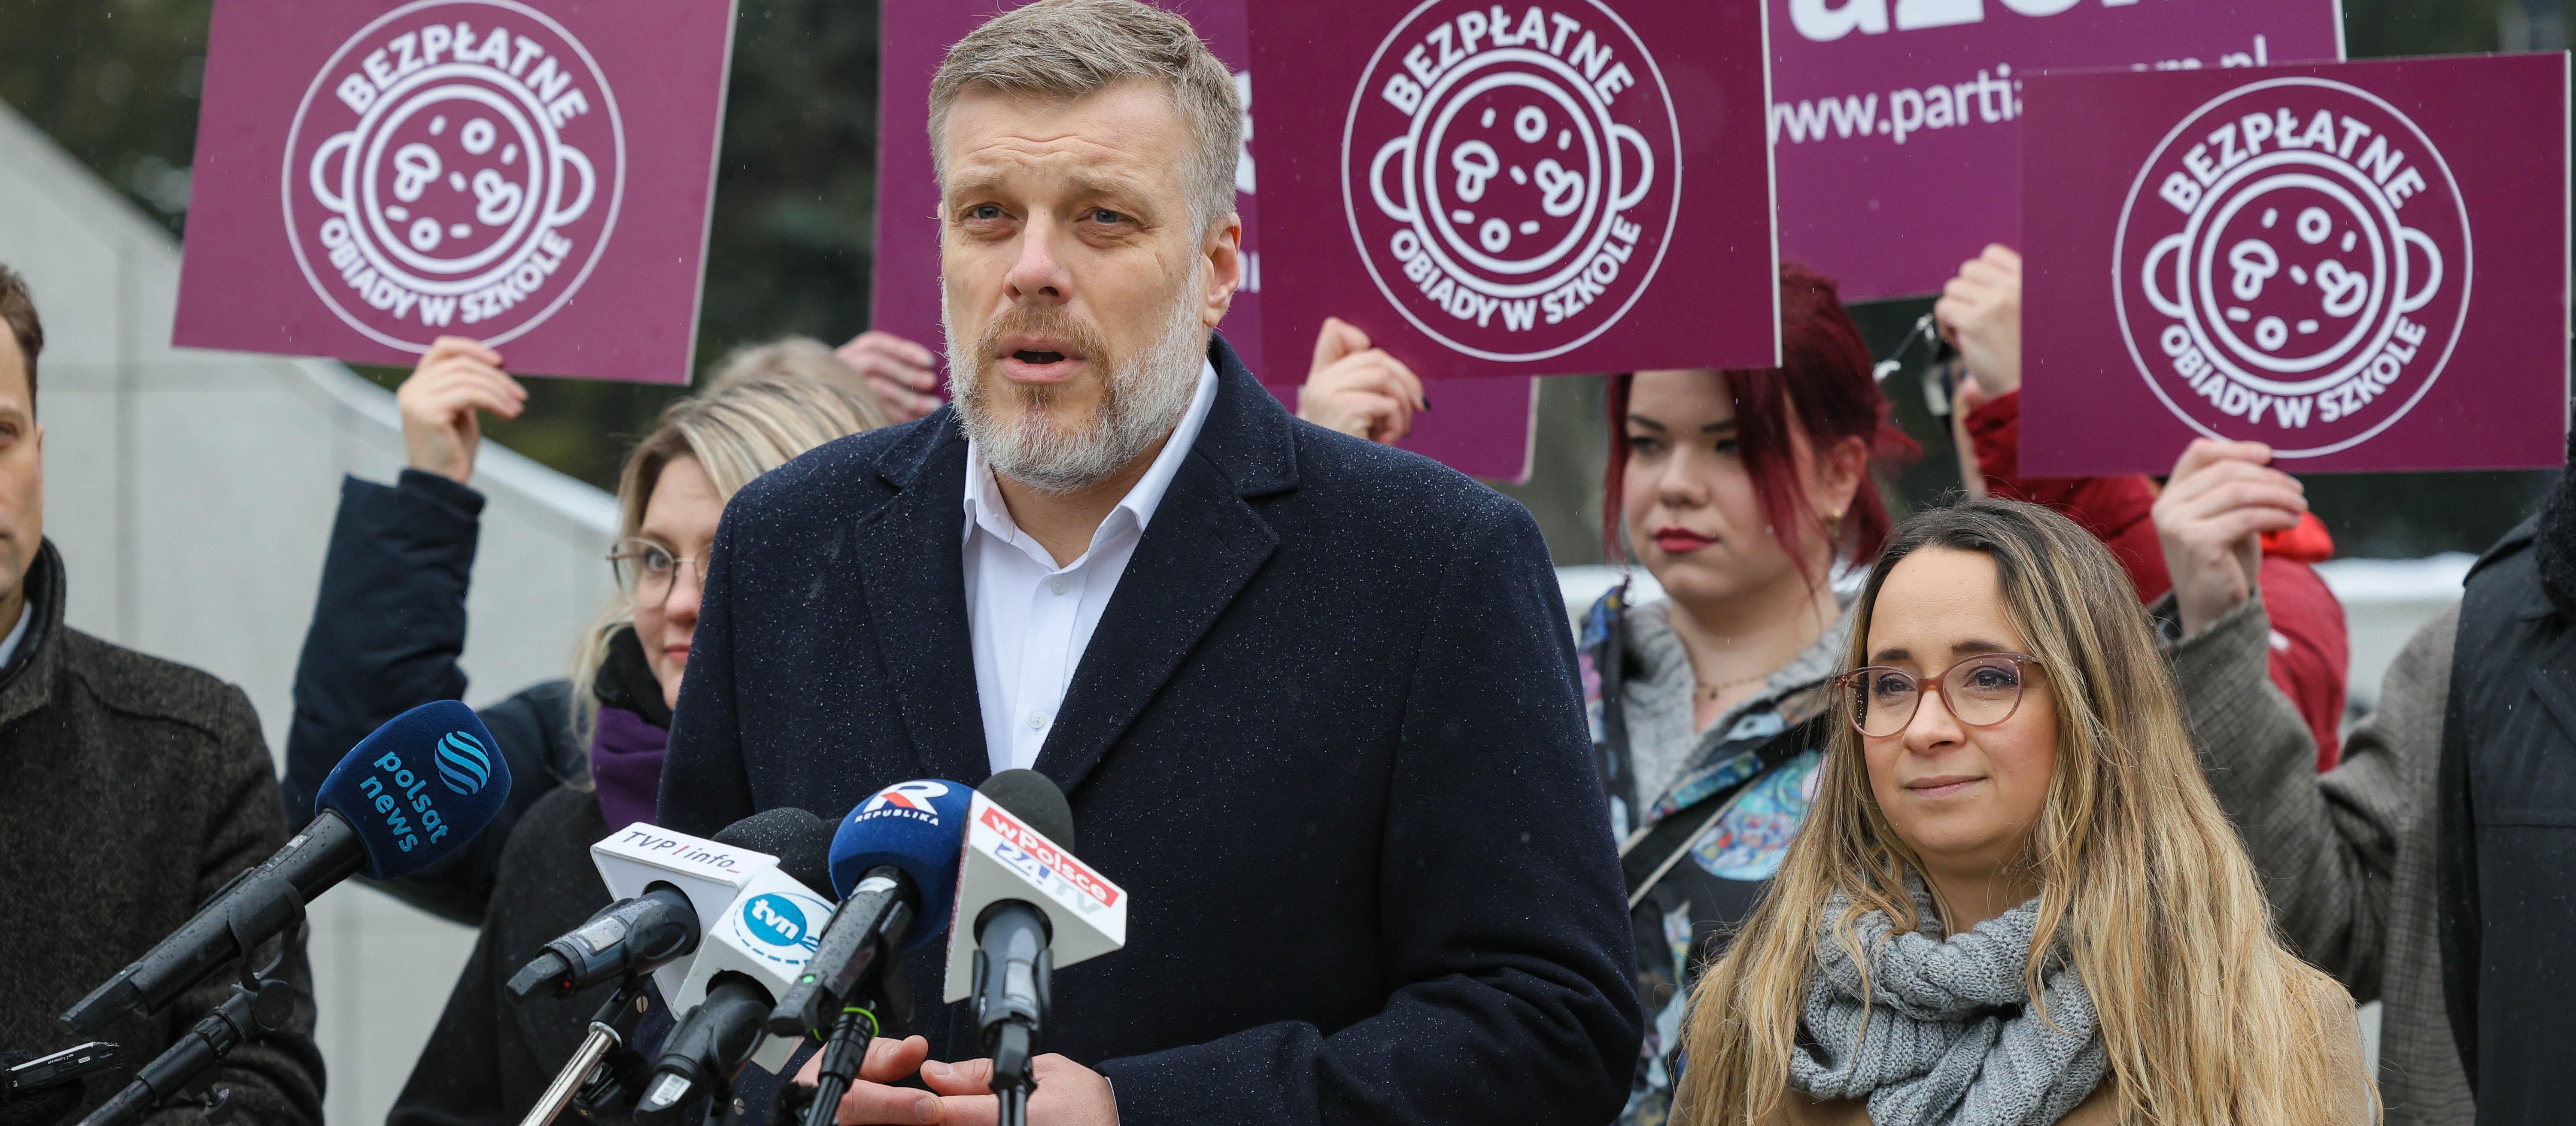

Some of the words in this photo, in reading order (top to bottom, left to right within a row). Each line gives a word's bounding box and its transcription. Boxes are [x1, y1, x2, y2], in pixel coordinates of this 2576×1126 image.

[335, 22, 589, 128] BEZPŁATNE
[1381, 5, 1635, 116] BEZPŁATNE
[1765, 62, 2022, 145] ww.parti
[2158, 108, 2427, 214] BEZPŁATNE
[320, 216, 418, 320] OBIADY
[419, 296, 456, 327] W
[460, 229, 573, 324] SZKOLE
[1390, 228, 1500, 328] OBIADY
[1501, 298, 1538, 332] W
[1541, 215, 1642, 325] SZKOLE
[2161, 323, 2274, 425] OBIADY
[2274, 396, 2313, 429] W
[2318, 316, 2427, 423] SZKOLE
[360, 776, 418, 852] news
[374, 751, 448, 844] polsat
[855, 809, 939, 826] REPUBLIKA
[991, 815, 1108, 902] wPolsce
[1054, 876, 1101, 914] TV
[751, 898, 800, 940] tvn
